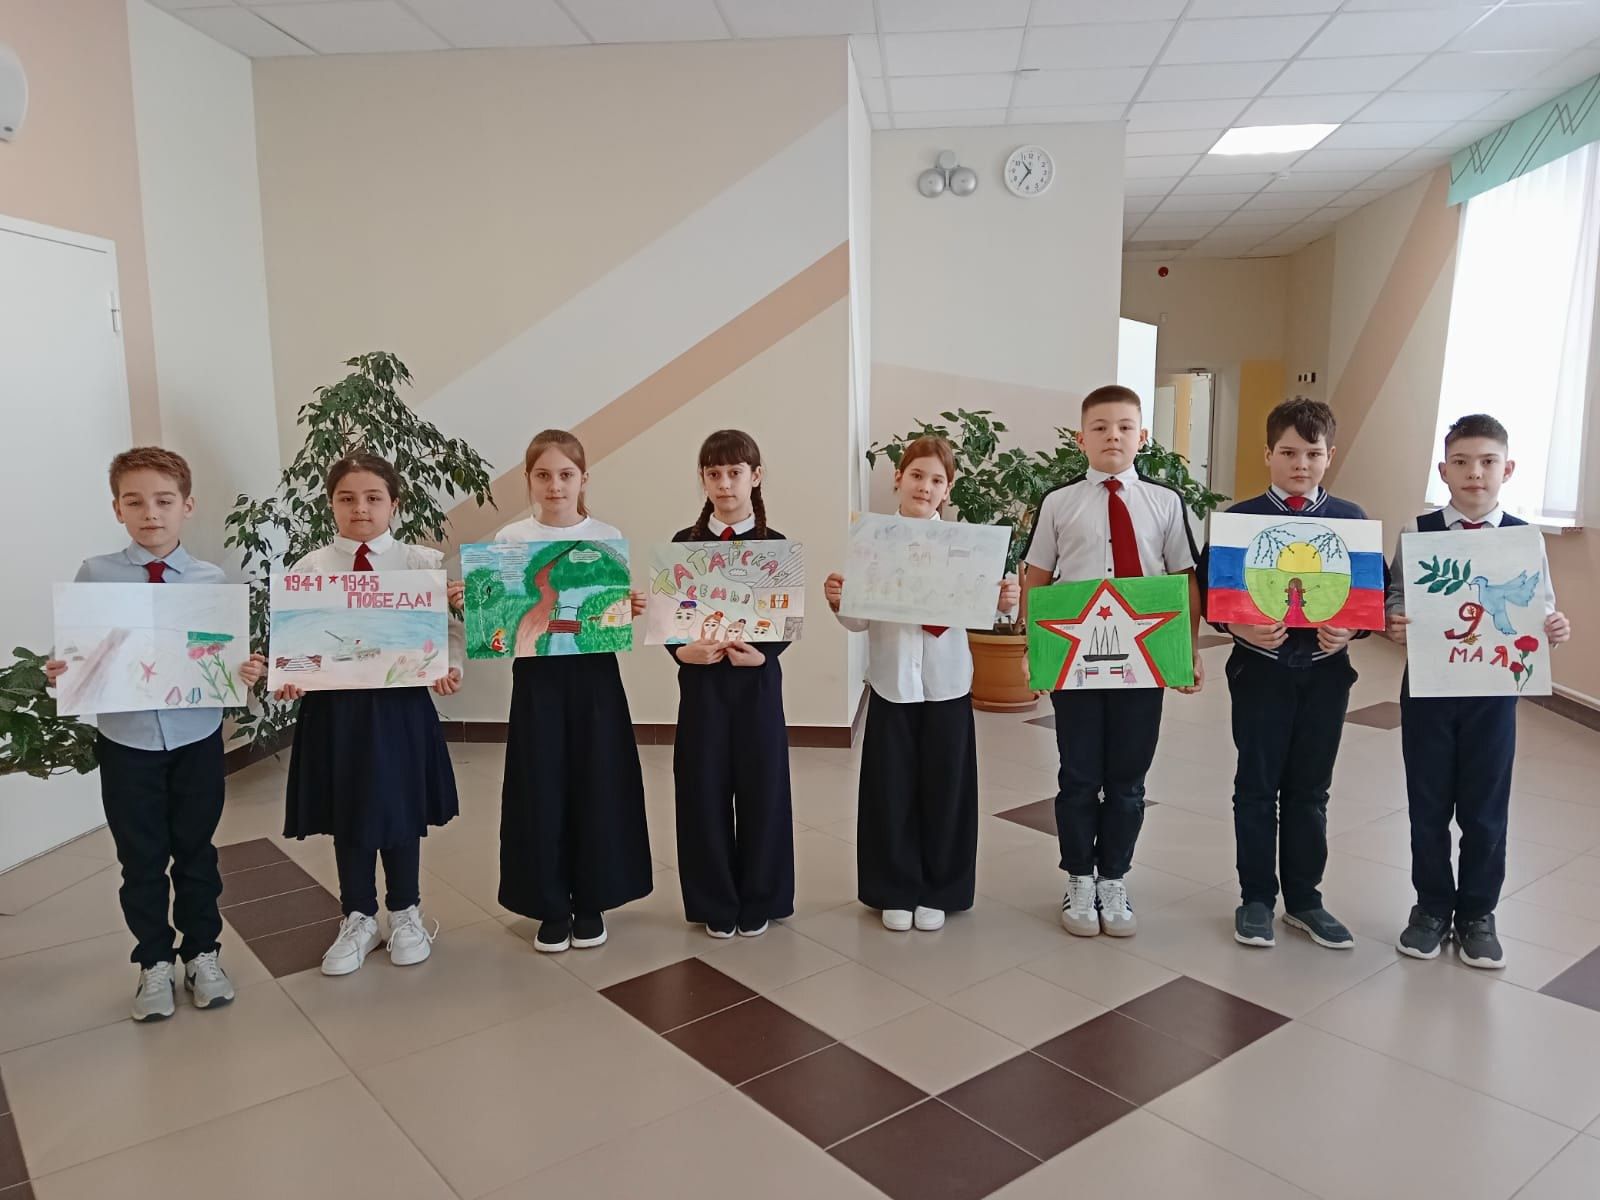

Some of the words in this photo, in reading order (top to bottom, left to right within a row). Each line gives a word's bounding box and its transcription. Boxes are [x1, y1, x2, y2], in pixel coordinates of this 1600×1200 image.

[284, 574, 324, 592] 1941
[341, 574, 380, 592] 1945
[347, 592, 432, 609] ПОБЕДА!
[686, 584, 751, 605] СЕМЬЯ
[1444, 601, 1485, 640] 9
[1449, 645, 1509, 668] МАЯ
